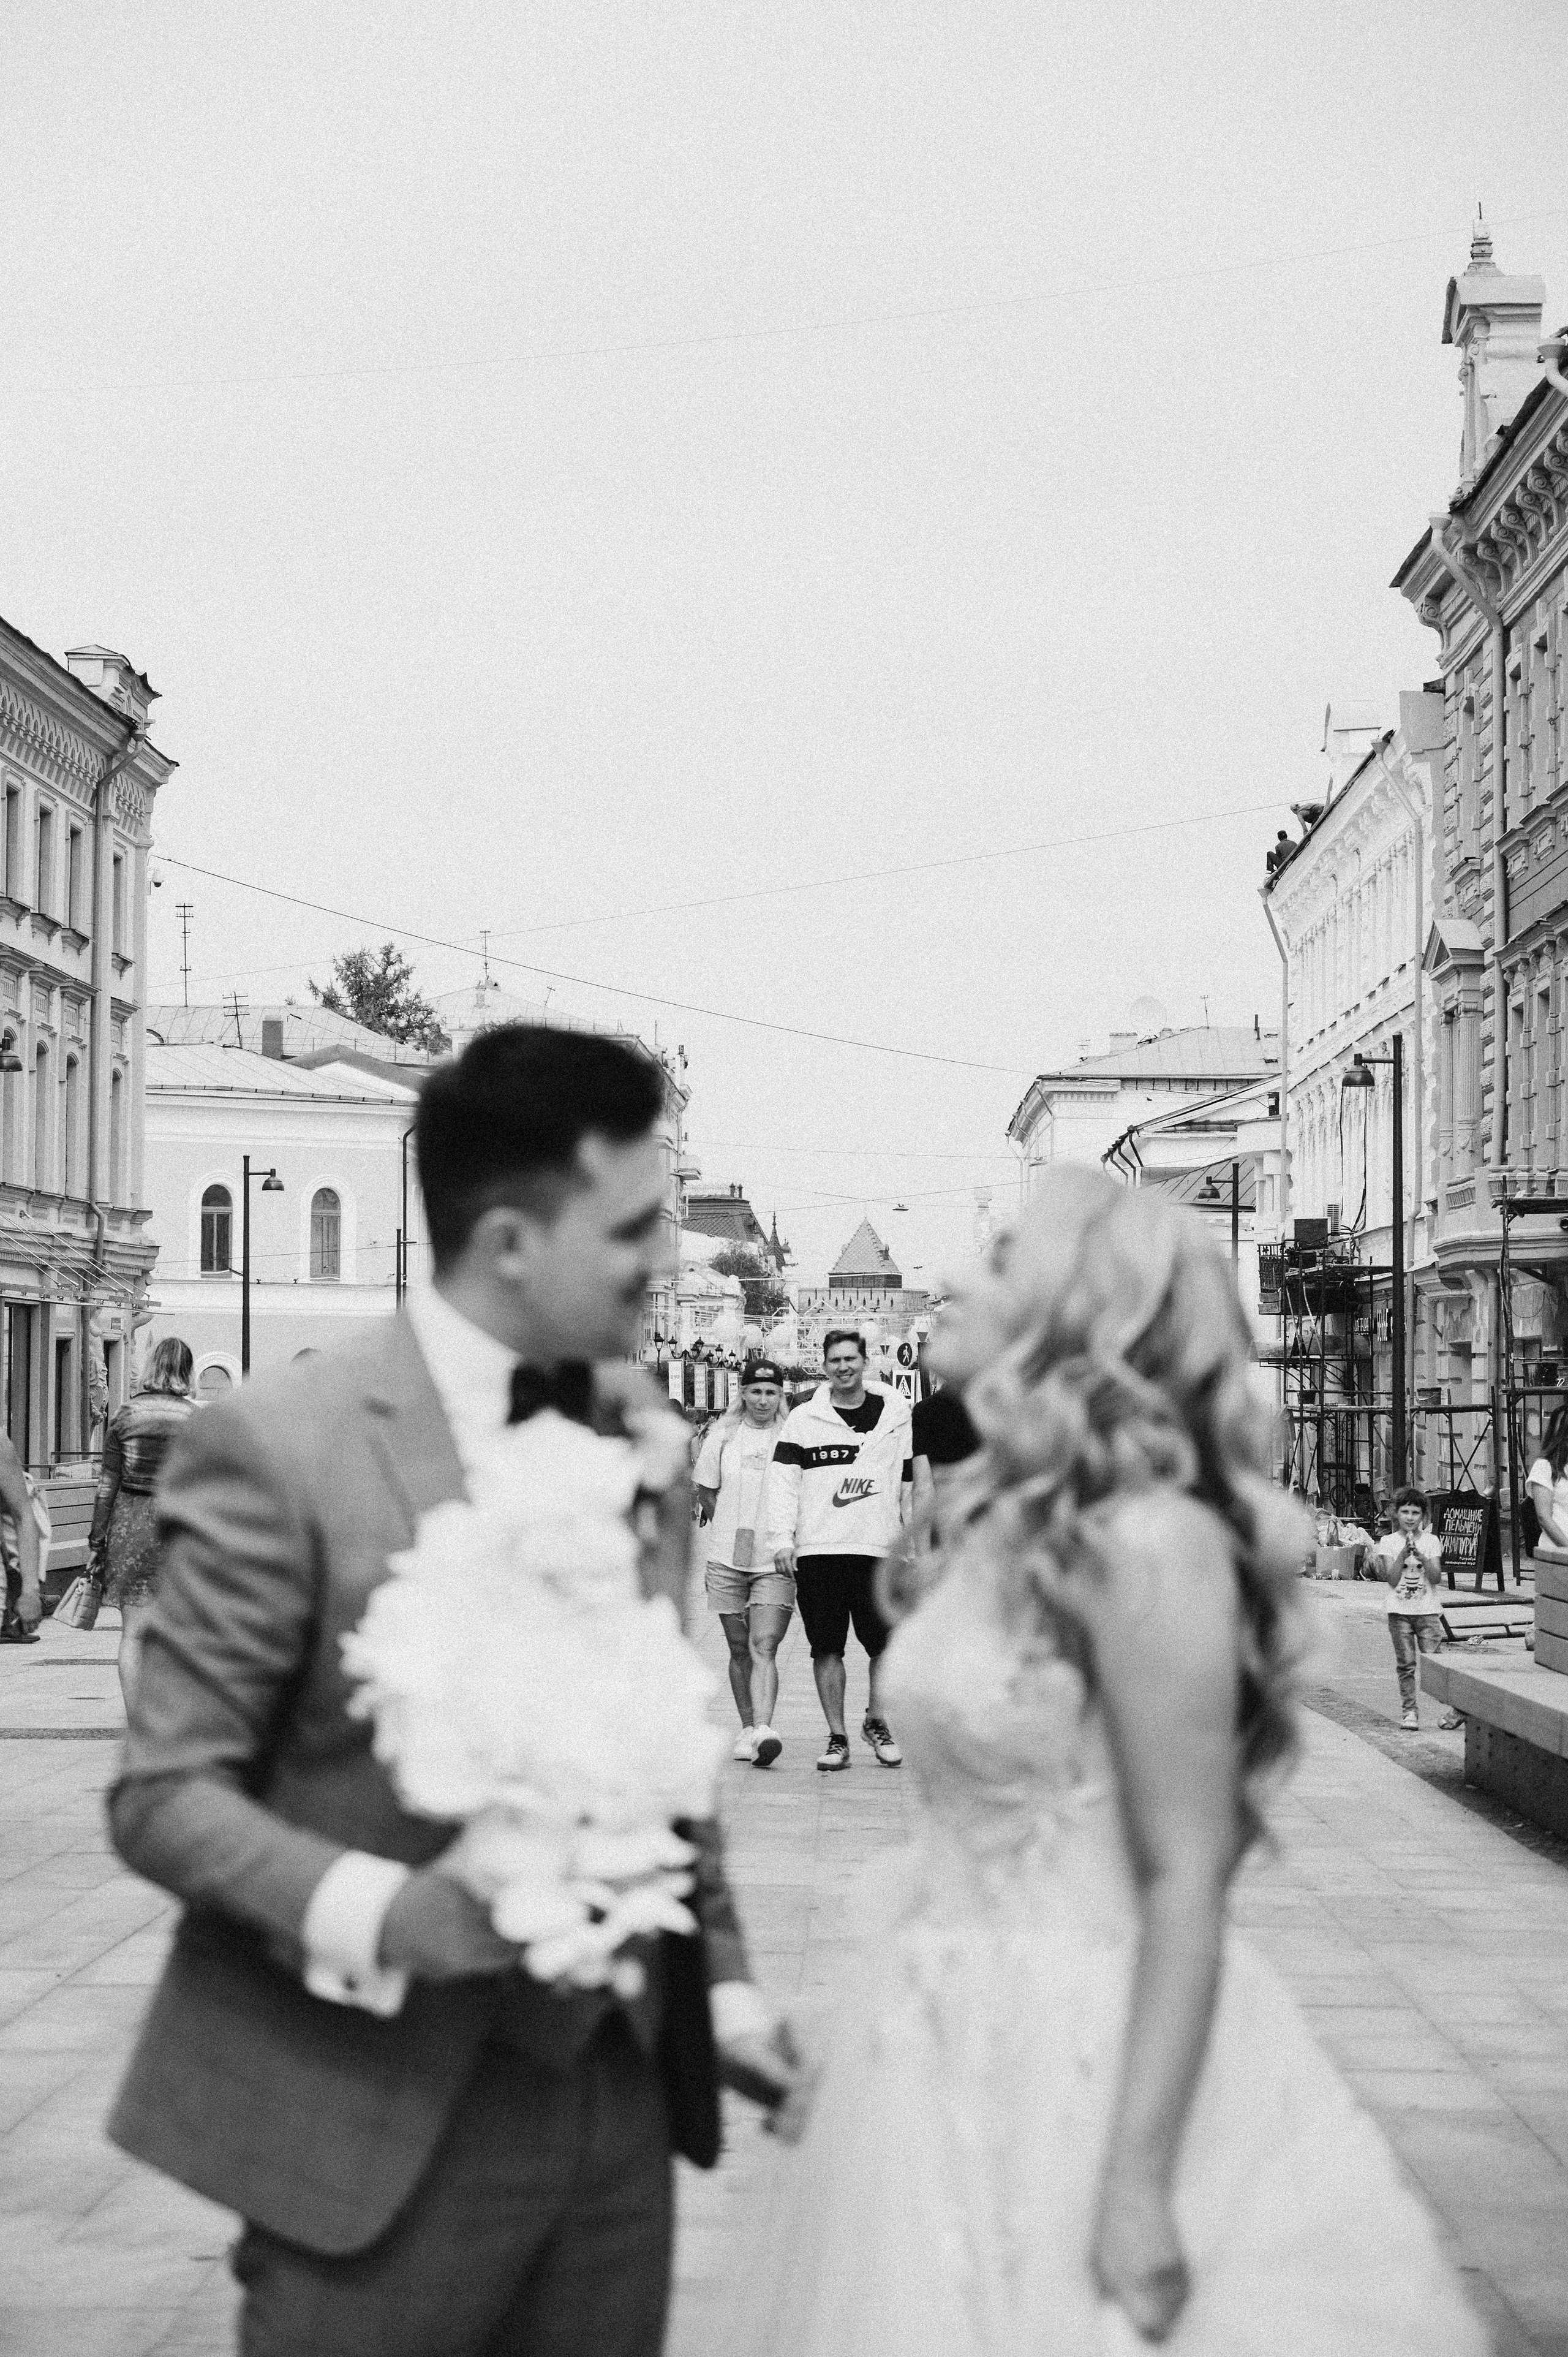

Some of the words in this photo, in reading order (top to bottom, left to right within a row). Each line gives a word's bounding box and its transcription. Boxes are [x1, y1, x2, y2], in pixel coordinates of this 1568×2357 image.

[812, 1450, 850, 1461] 1987
[840, 1478, 875, 1494] NIKE
[1444, 1507, 1483, 1522] ДОМАШНИЕ
[1445, 1519, 1482, 1535] ПЕЛЬМЕНИ
